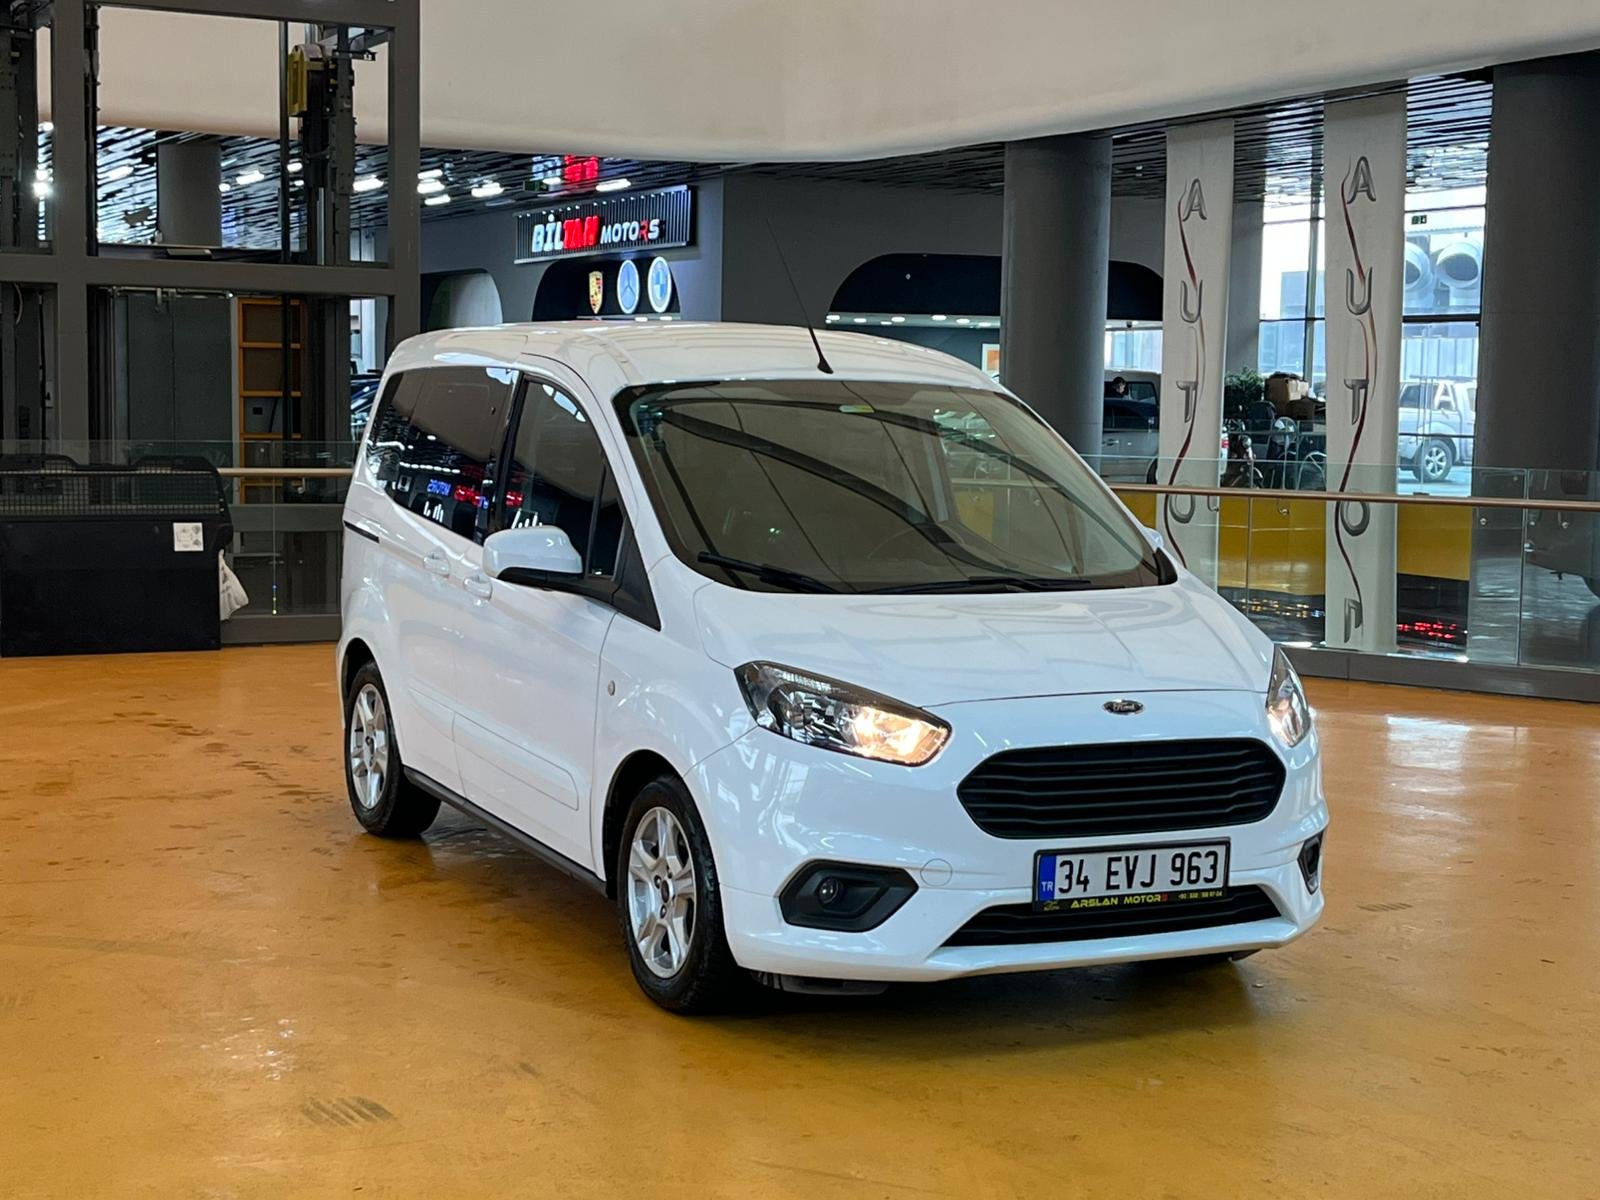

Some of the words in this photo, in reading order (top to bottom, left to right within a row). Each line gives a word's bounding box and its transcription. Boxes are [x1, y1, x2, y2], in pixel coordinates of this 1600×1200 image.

[600, 218, 660, 244] MOTORS
[1058, 858, 1090, 894] 34
[1105, 853, 1157, 891] EVJ
[1170, 850, 1219, 886] 963
[1041, 881, 1054, 892] TR
[1070, 896, 1119, 909] ARSLAN
